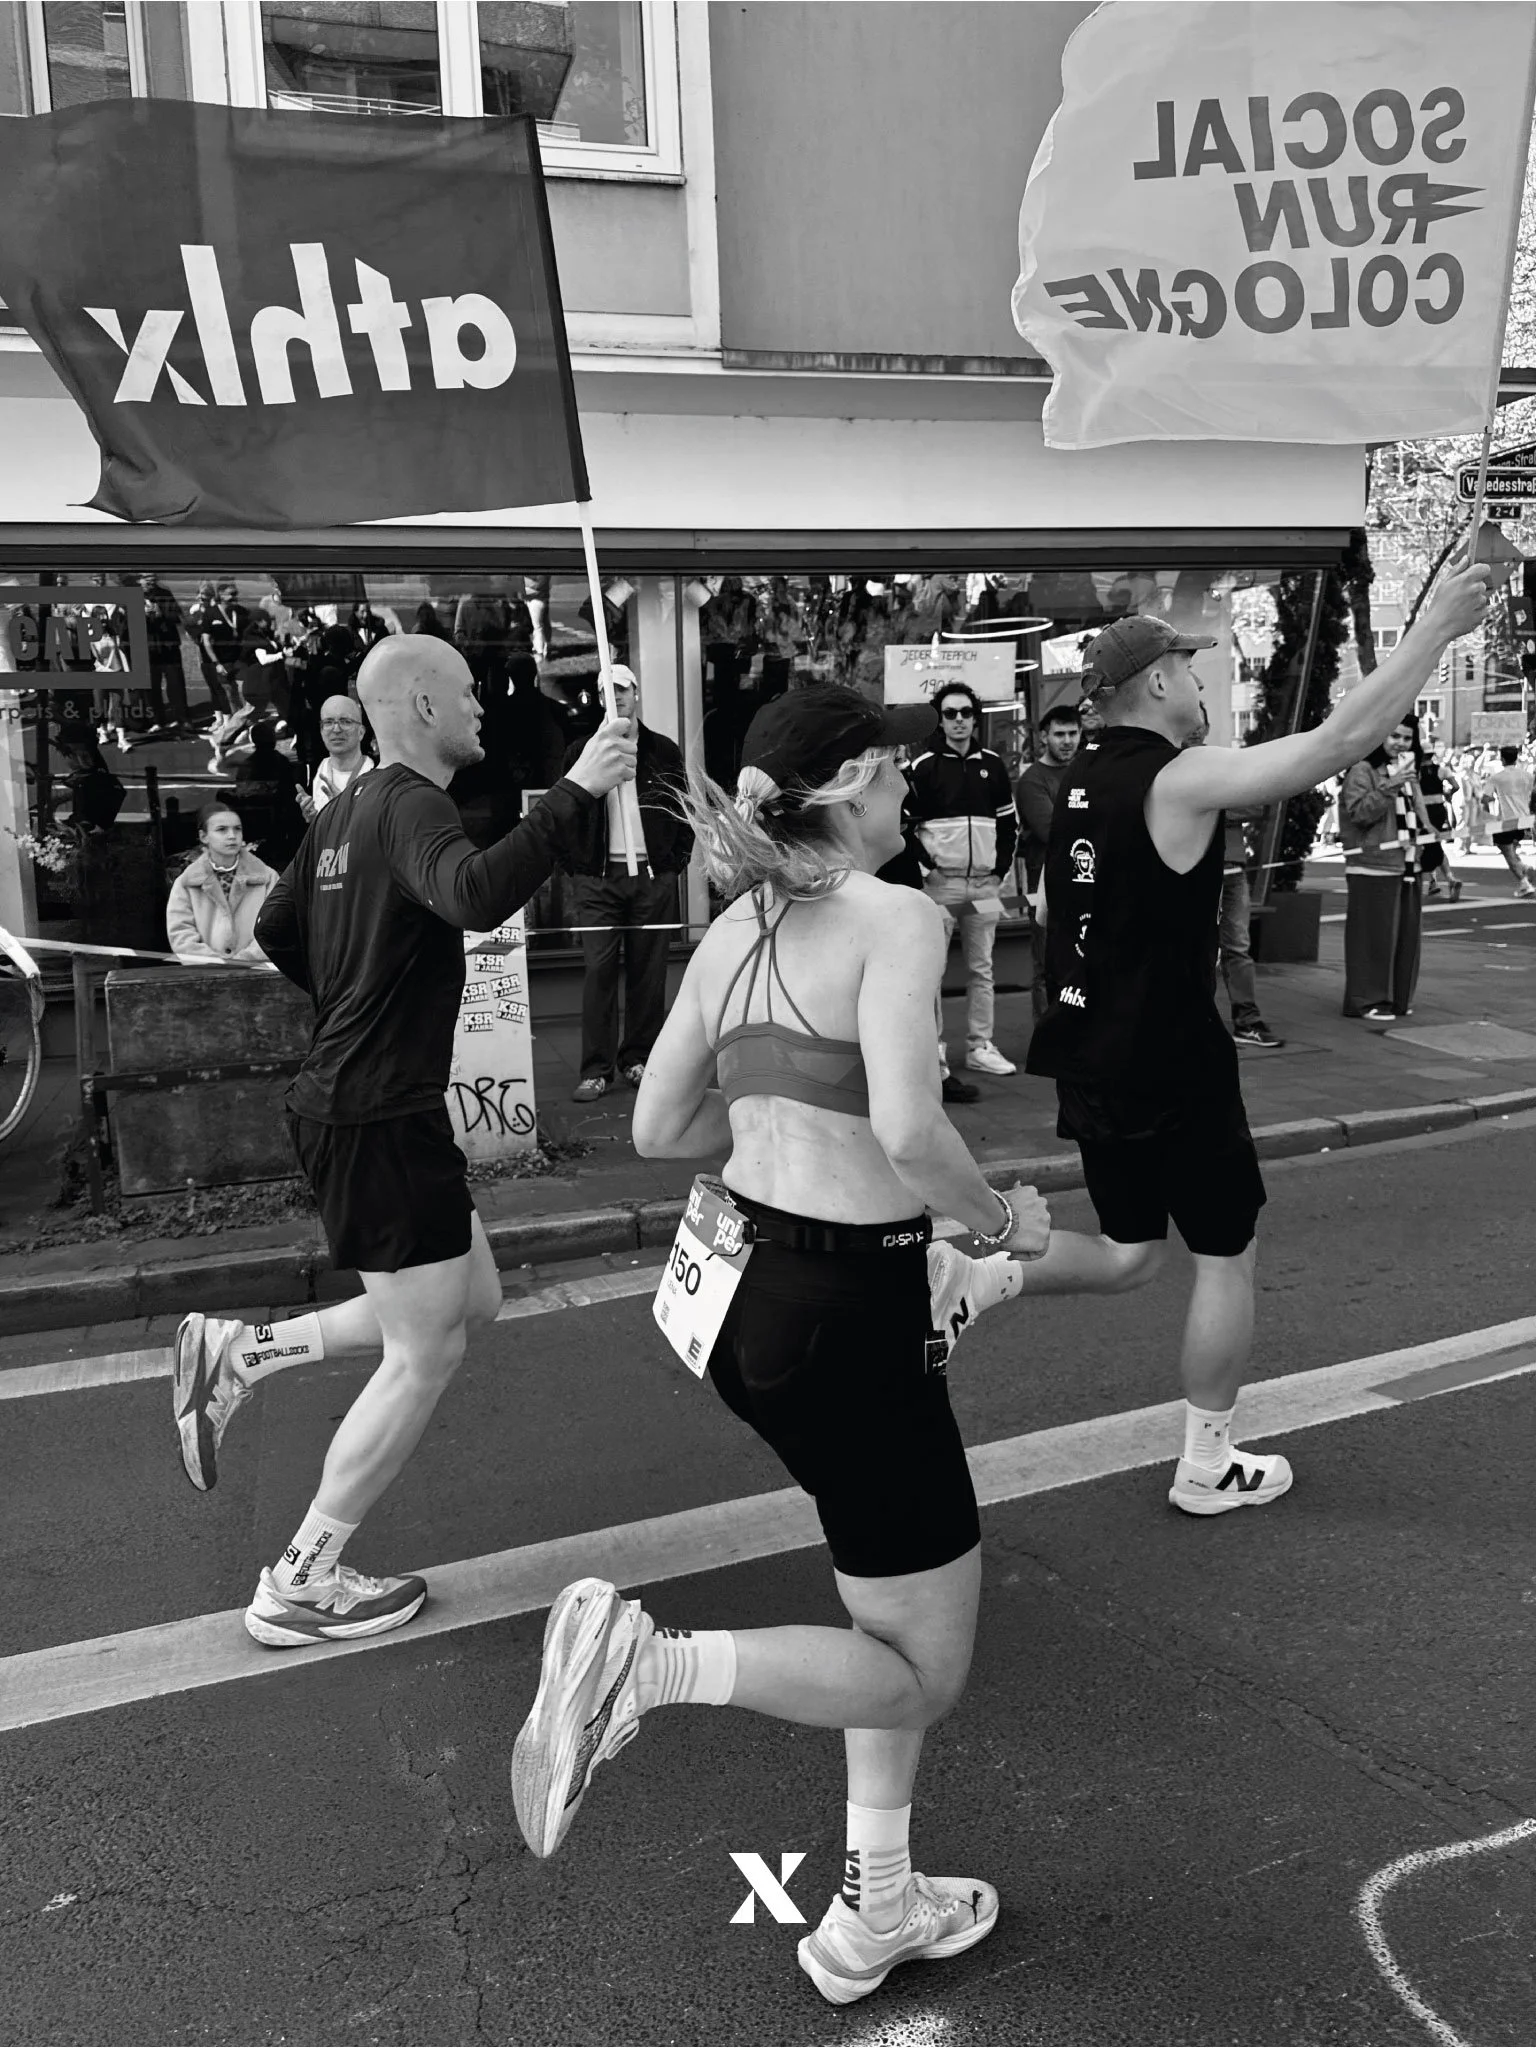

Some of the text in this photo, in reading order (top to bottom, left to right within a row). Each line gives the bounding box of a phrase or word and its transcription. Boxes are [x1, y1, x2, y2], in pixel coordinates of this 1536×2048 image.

[63, 700, 80, 718] &
[476, 955, 504, 966] KSR
[490, 975, 520, 991] KSR
[498, 1000, 527, 1017] KSR
[464, 1013, 493, 1026] KSR
[716, 1212, 743, 1239] uni
[713, 1228, 742, 1254] per
[670, 1242, 702, 1296] 150
